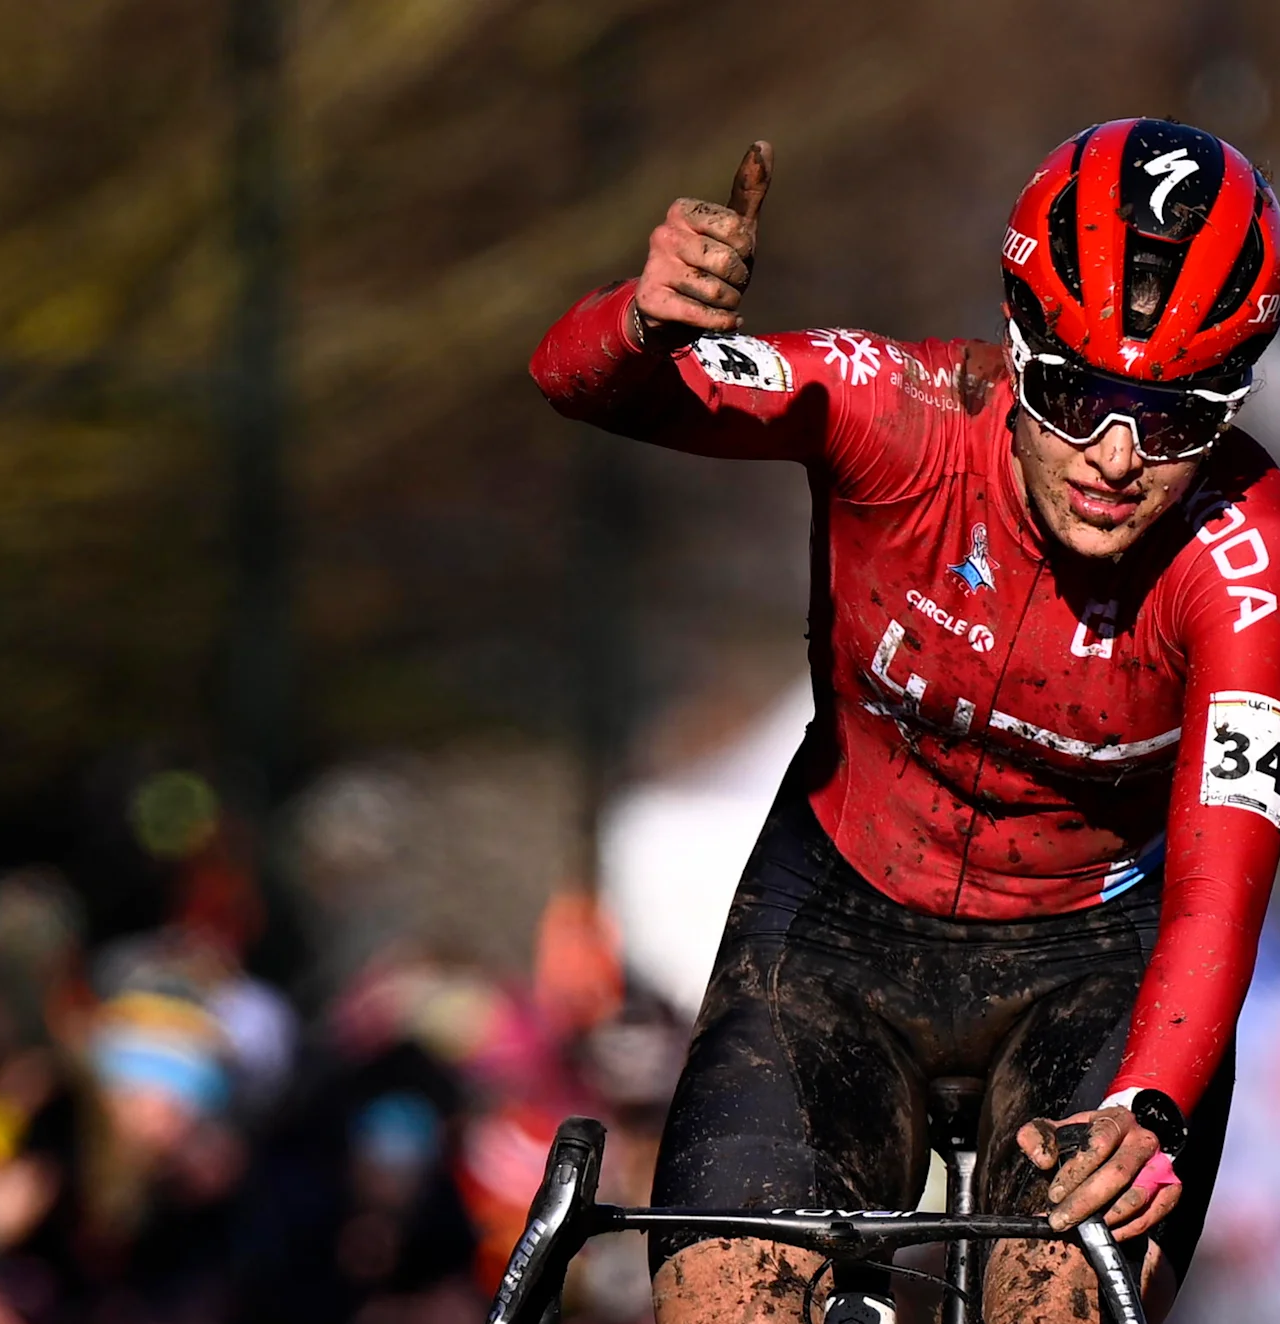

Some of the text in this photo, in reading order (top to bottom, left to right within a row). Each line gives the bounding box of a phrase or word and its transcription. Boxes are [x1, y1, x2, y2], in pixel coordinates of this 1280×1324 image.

[906, 589, 994, 652] CIRCLE K
[1248, 699, 1270, 711] UCI
